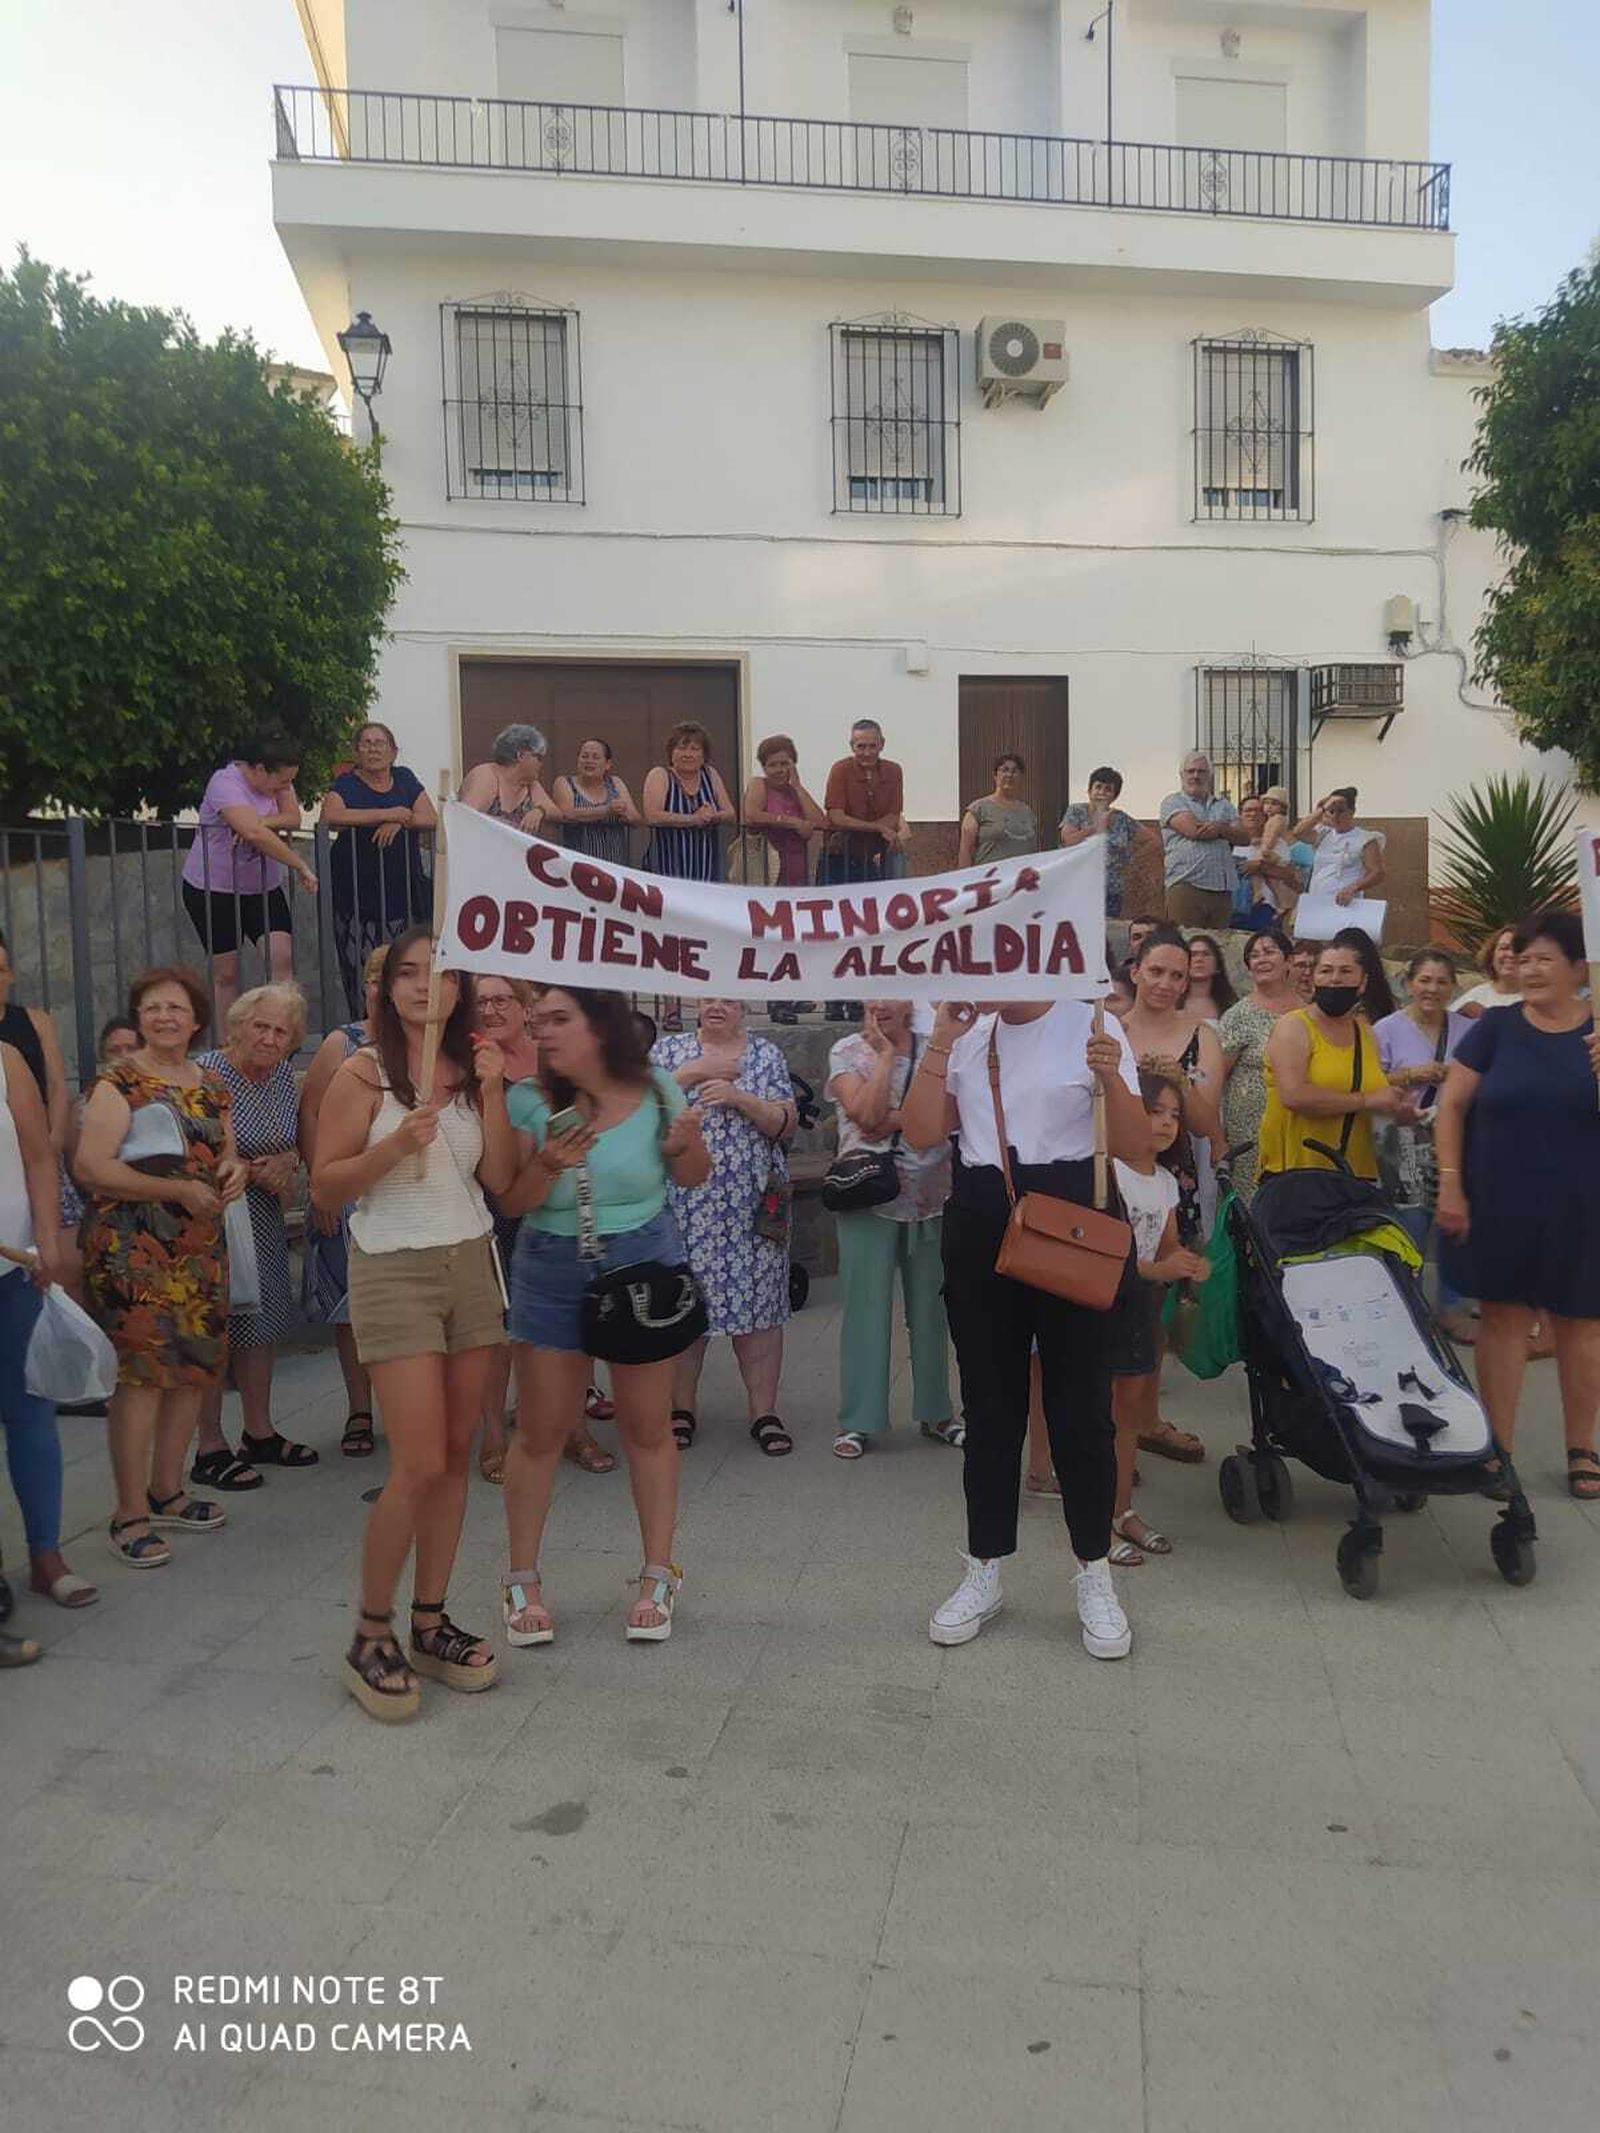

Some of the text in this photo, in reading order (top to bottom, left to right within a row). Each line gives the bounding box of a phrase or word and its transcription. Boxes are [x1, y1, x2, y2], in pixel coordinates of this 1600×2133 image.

[526, 843, 1041, 942] CON MINORÍA
[737, 947, 801, 981] LA
[834, 911, 1085, 977] ALCALDÍA
